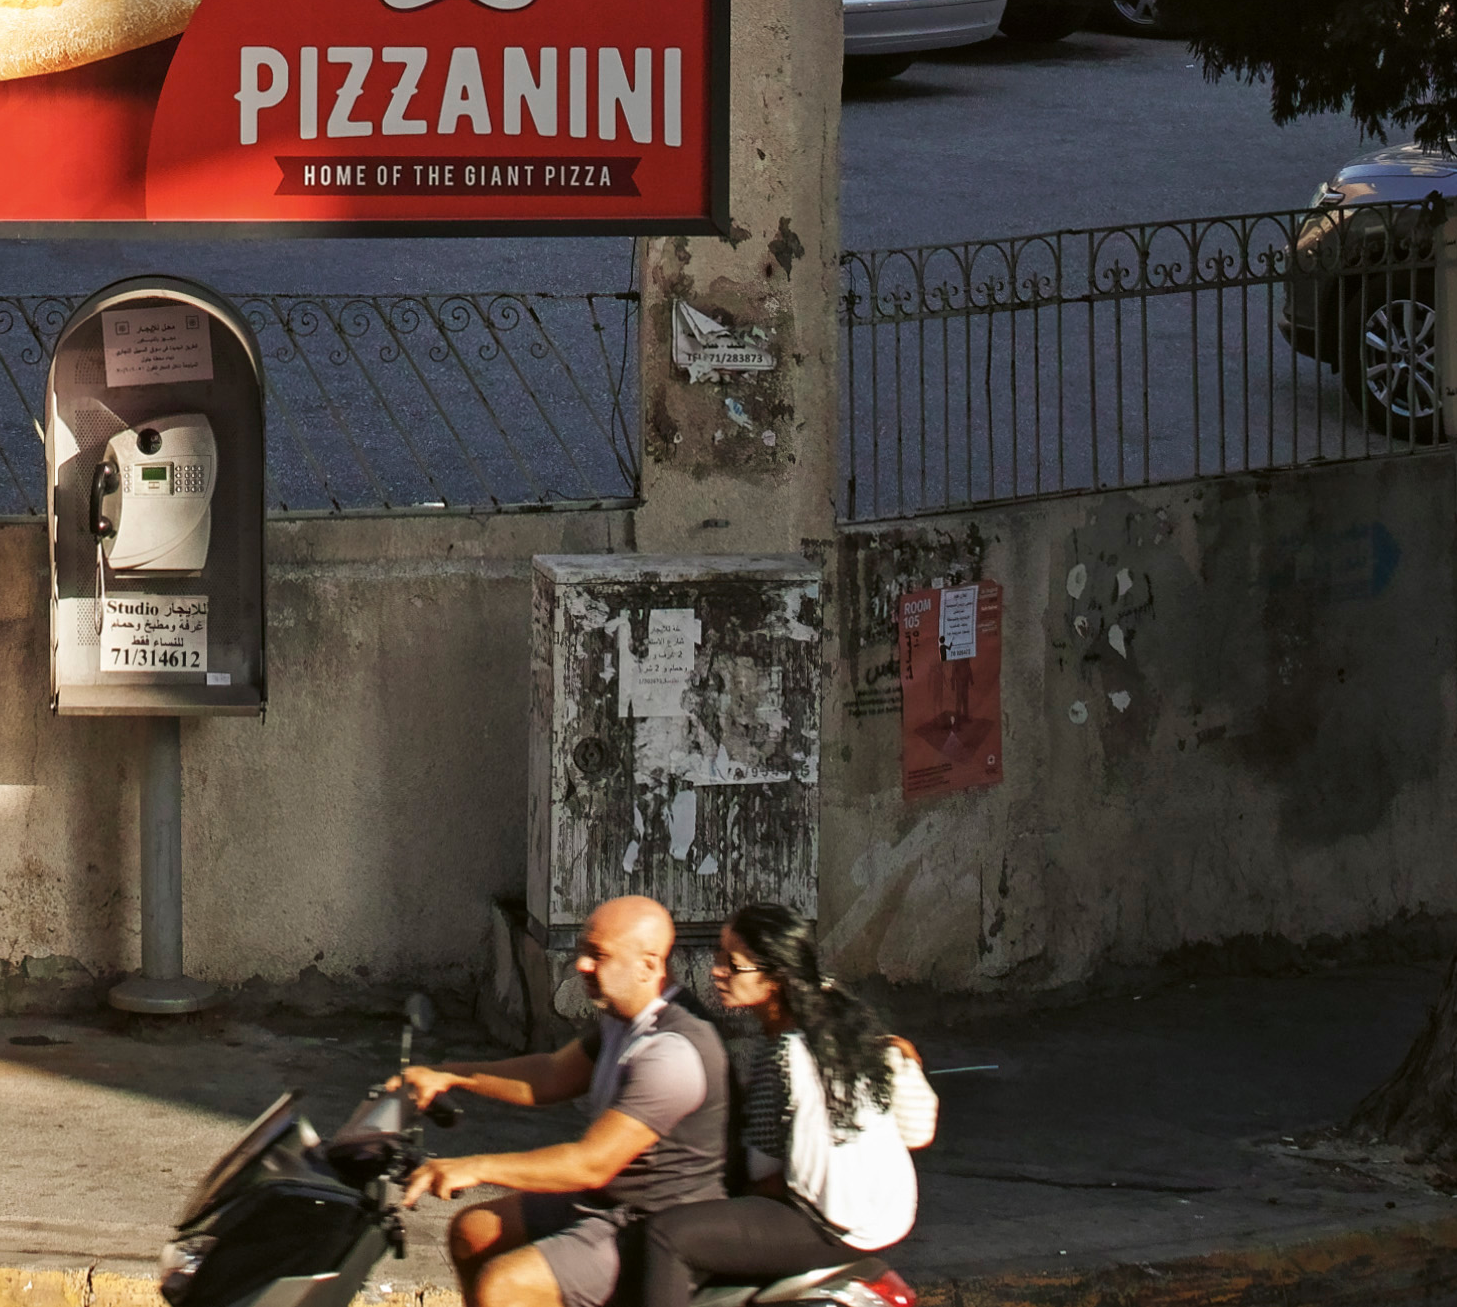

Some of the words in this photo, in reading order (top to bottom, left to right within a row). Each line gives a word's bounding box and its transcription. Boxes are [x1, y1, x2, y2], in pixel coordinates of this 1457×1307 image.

[233, 46, 683, 147] PIZZANINI
[304, 165, 366, 186] HOME
[377, 165, 403, 185] OF
[414, 165, 455, 186] THE
[464, 165, 535, 187] GIANT
[544, 165, 613, 187] PIZZA
[709, 353, 764, 365] 71/283873
[107, 599, 159, 616] Studio
[904, 598, 933, 616] ROOM
[179, 618, 204, 634] غرفة
[903, 614, 920, 630] 105
[131, 634, 150, 647] فقط
[110, 647, 201, 669] 71/314612
